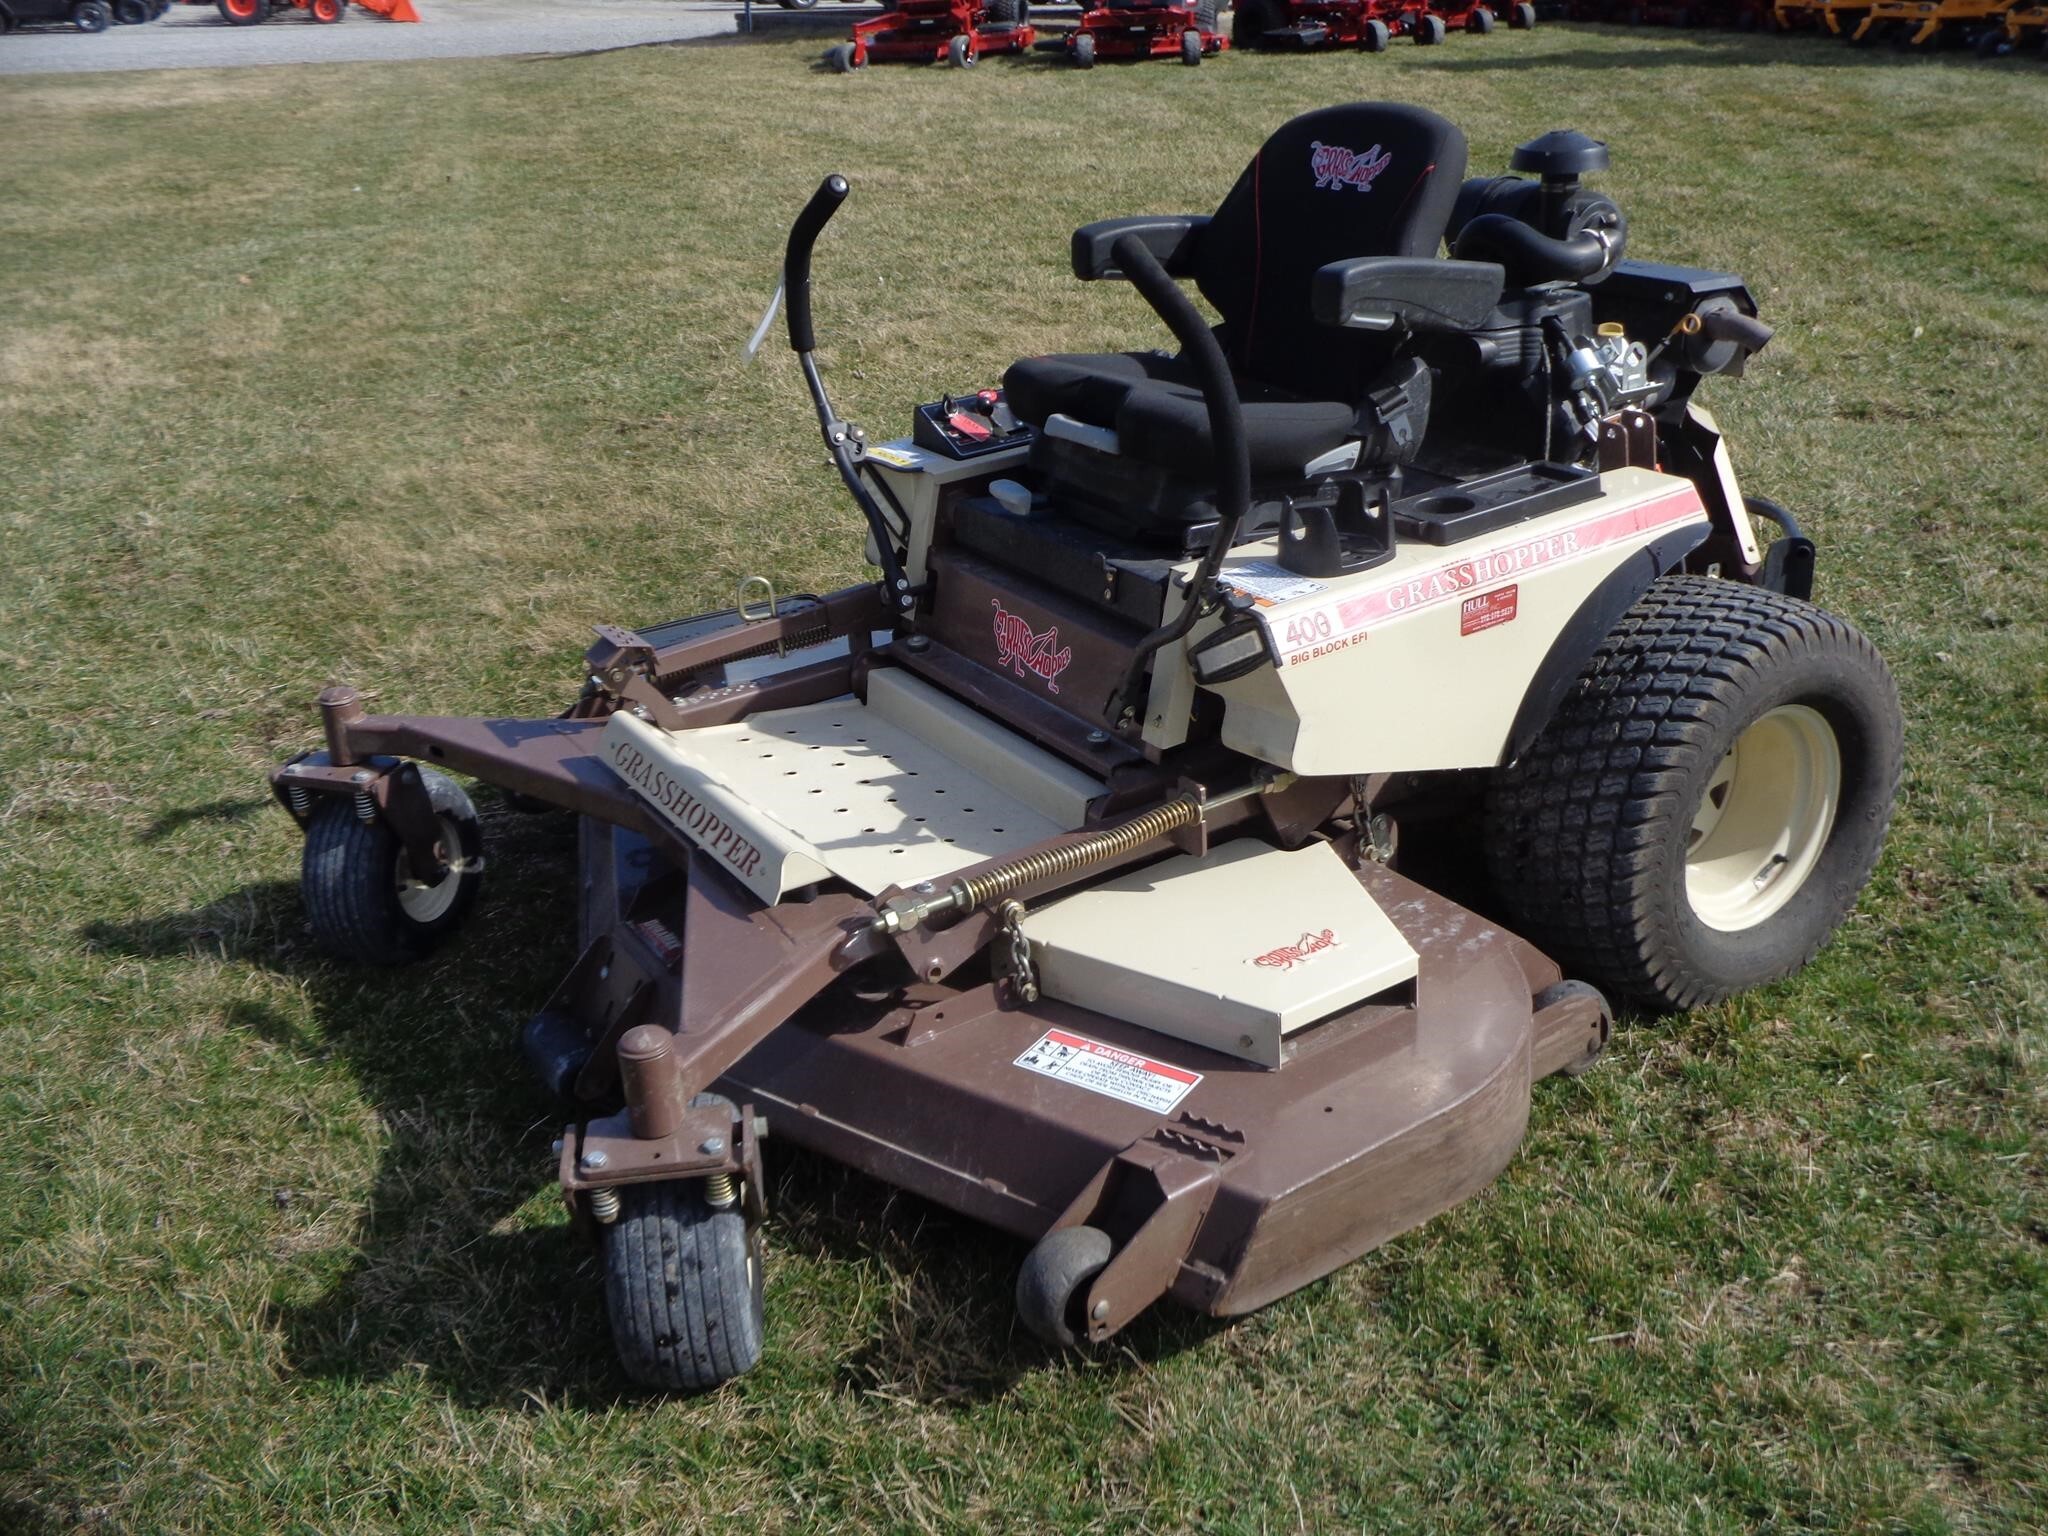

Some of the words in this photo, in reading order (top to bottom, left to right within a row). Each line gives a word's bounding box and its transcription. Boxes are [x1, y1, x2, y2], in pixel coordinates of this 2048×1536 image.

[1387, 531, 1580, 611] GRASSHOPPER
[1463, 596, 1489, 613] HULL
[1290, 651, 1310, 666] BIG
[1312, 638, 1349, 658] BLOCK
[1351, 631, 1368, 646] EFI
[615, 741, 762, 878] GRASSHOPPER
[1094, 1046, 1146, 1068] DANGER
